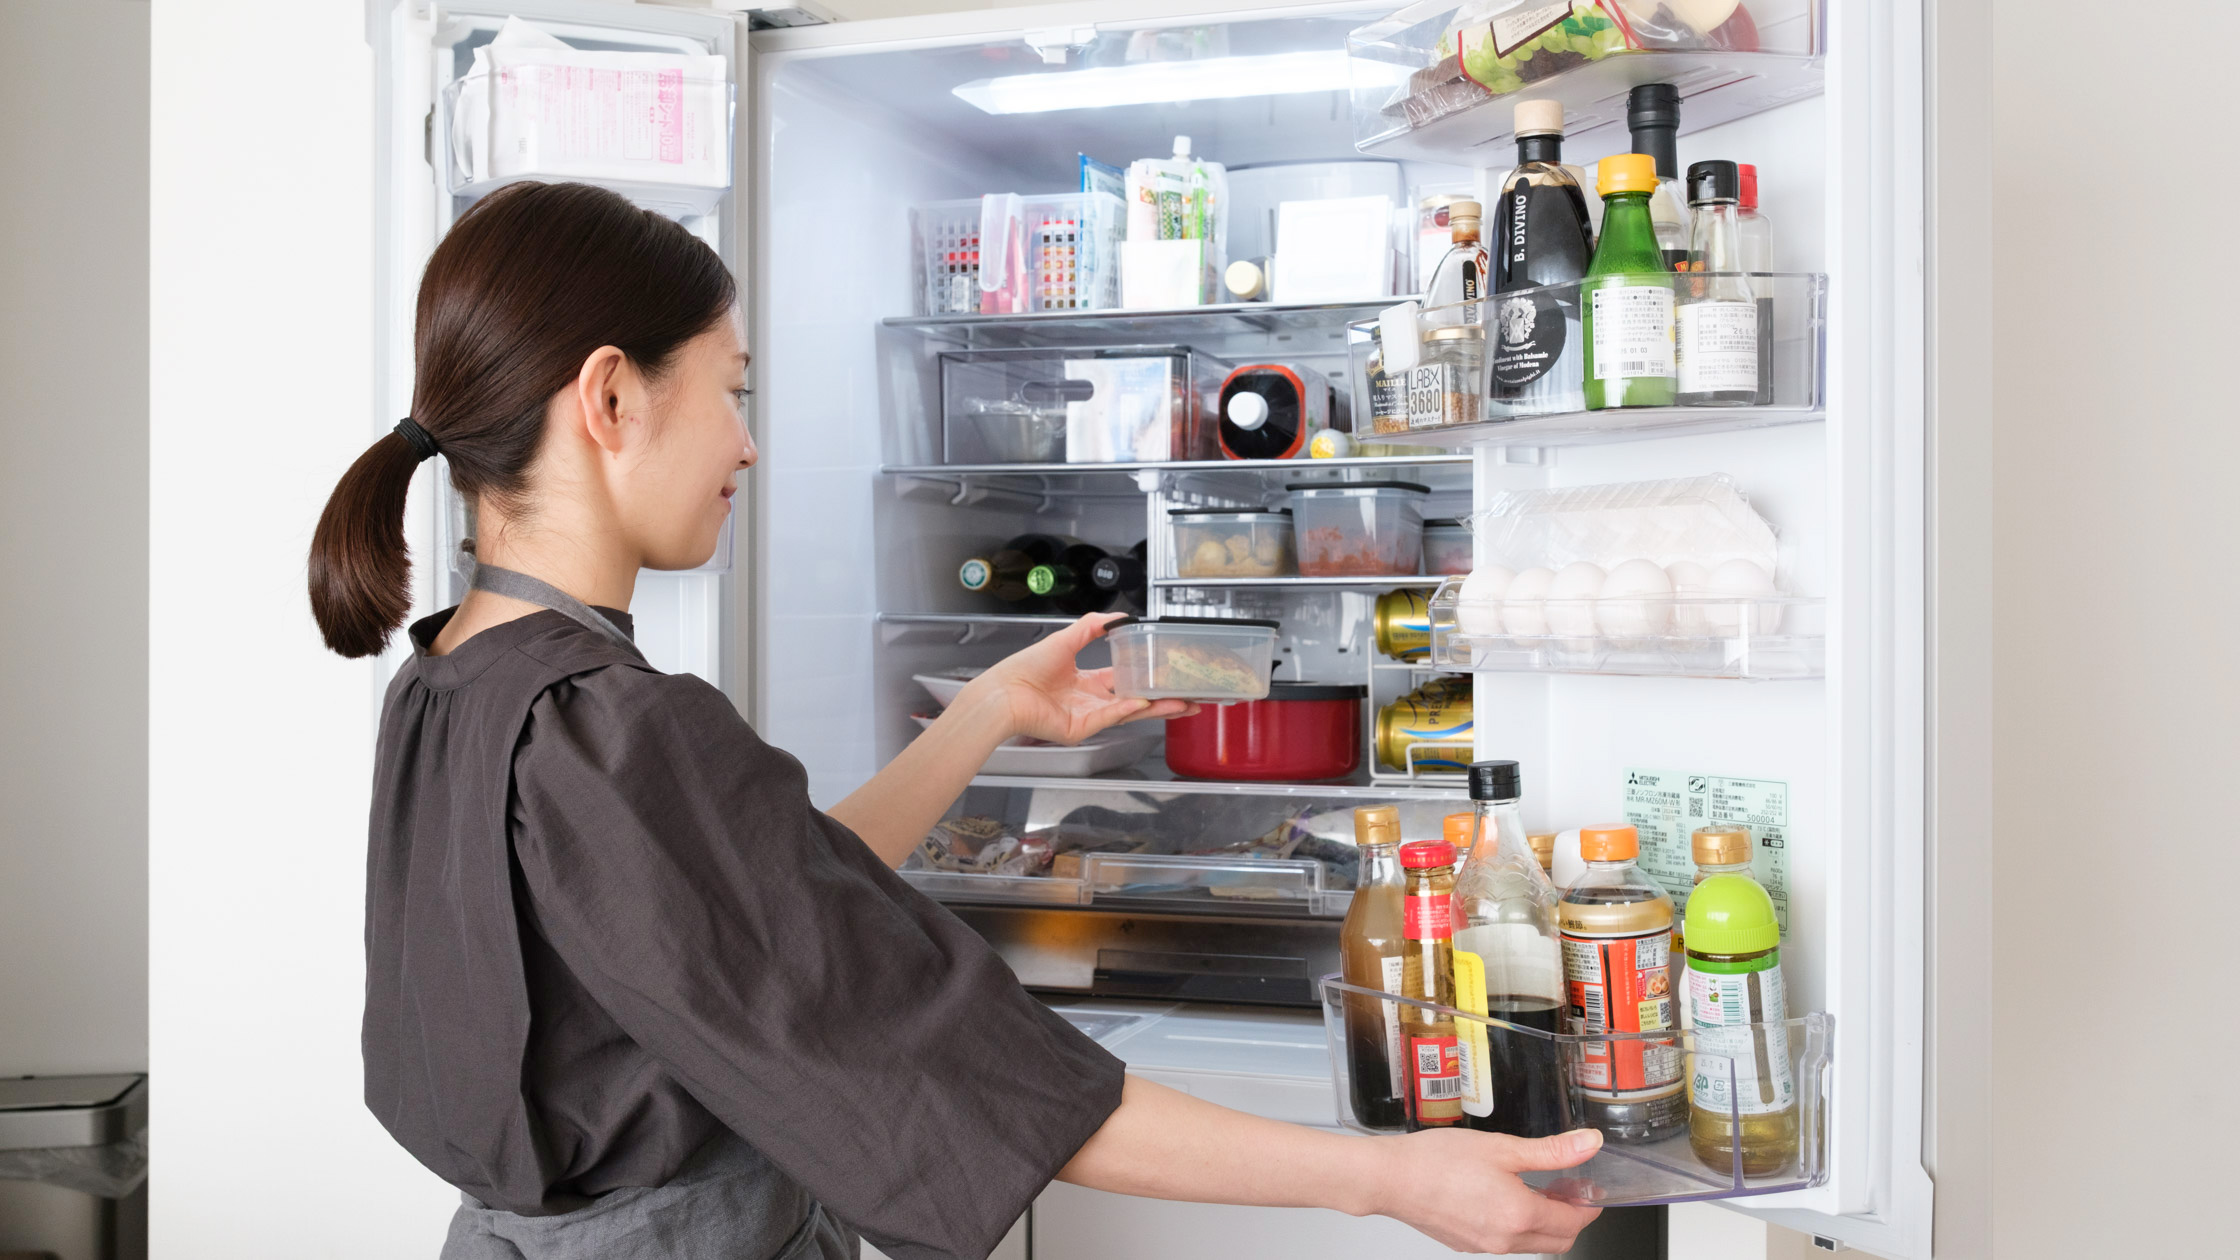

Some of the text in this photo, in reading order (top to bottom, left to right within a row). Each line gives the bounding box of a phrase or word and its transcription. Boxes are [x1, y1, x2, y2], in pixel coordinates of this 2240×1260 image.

[658, 72, 678, 128] 冷却シート
[1514, 194, 1527, 262] B. DIVINO
[1524, 351, 1548, 359] Balsamic
[1376, 379, 1406, 387] MAILLE
[1411, 366, 1440, 390] LABX
[1411, 388, 1440, 415] 3680
[1712, 811, 1775, 823] 製造番号 500004
